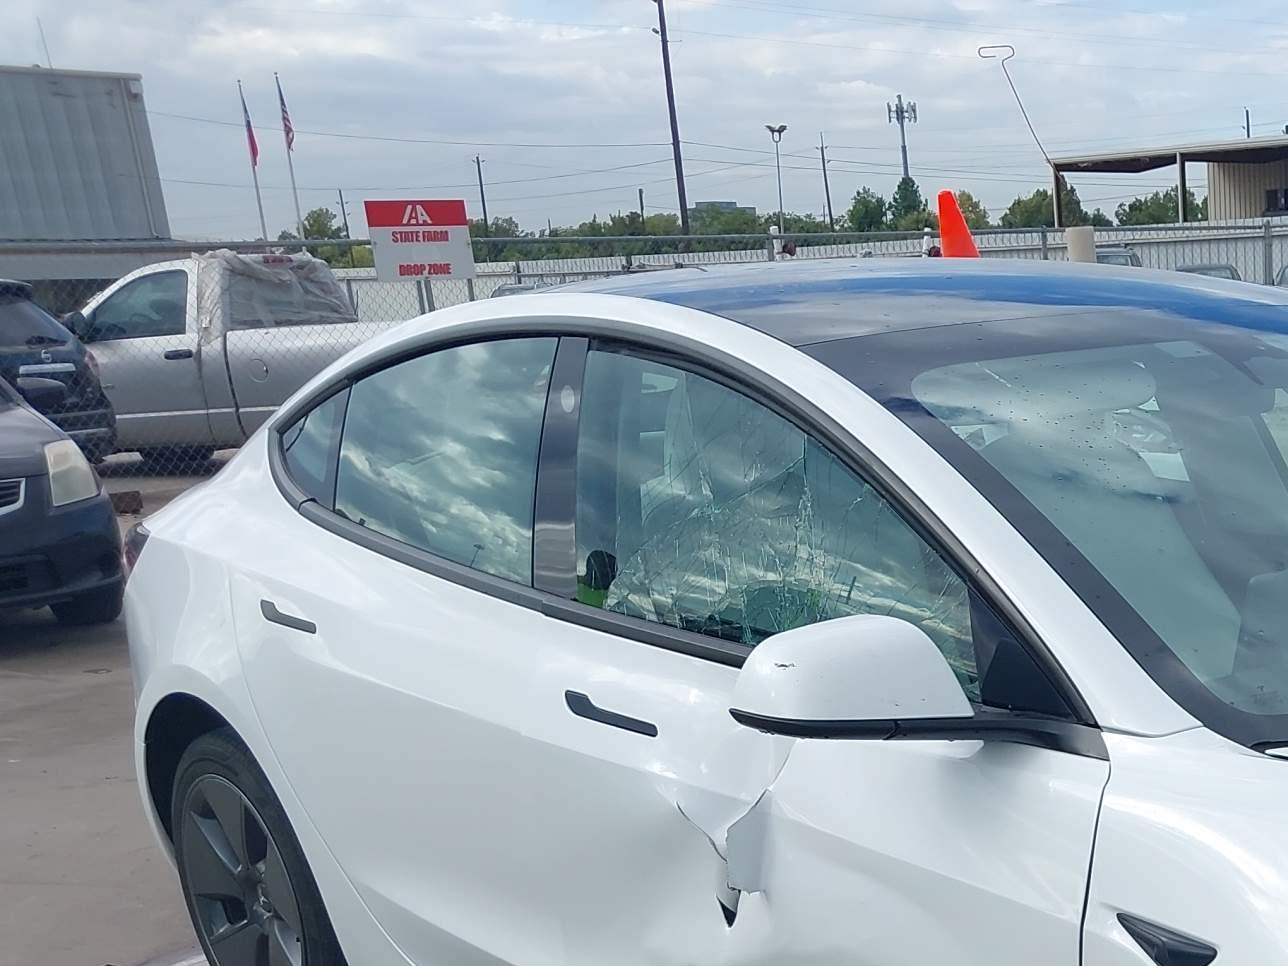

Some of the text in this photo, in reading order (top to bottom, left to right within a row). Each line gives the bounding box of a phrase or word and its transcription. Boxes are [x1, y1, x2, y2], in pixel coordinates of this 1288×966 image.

[392, 230, 449, 243] STATE FARM
[399, 262, 452, 277] DROP ZONE
